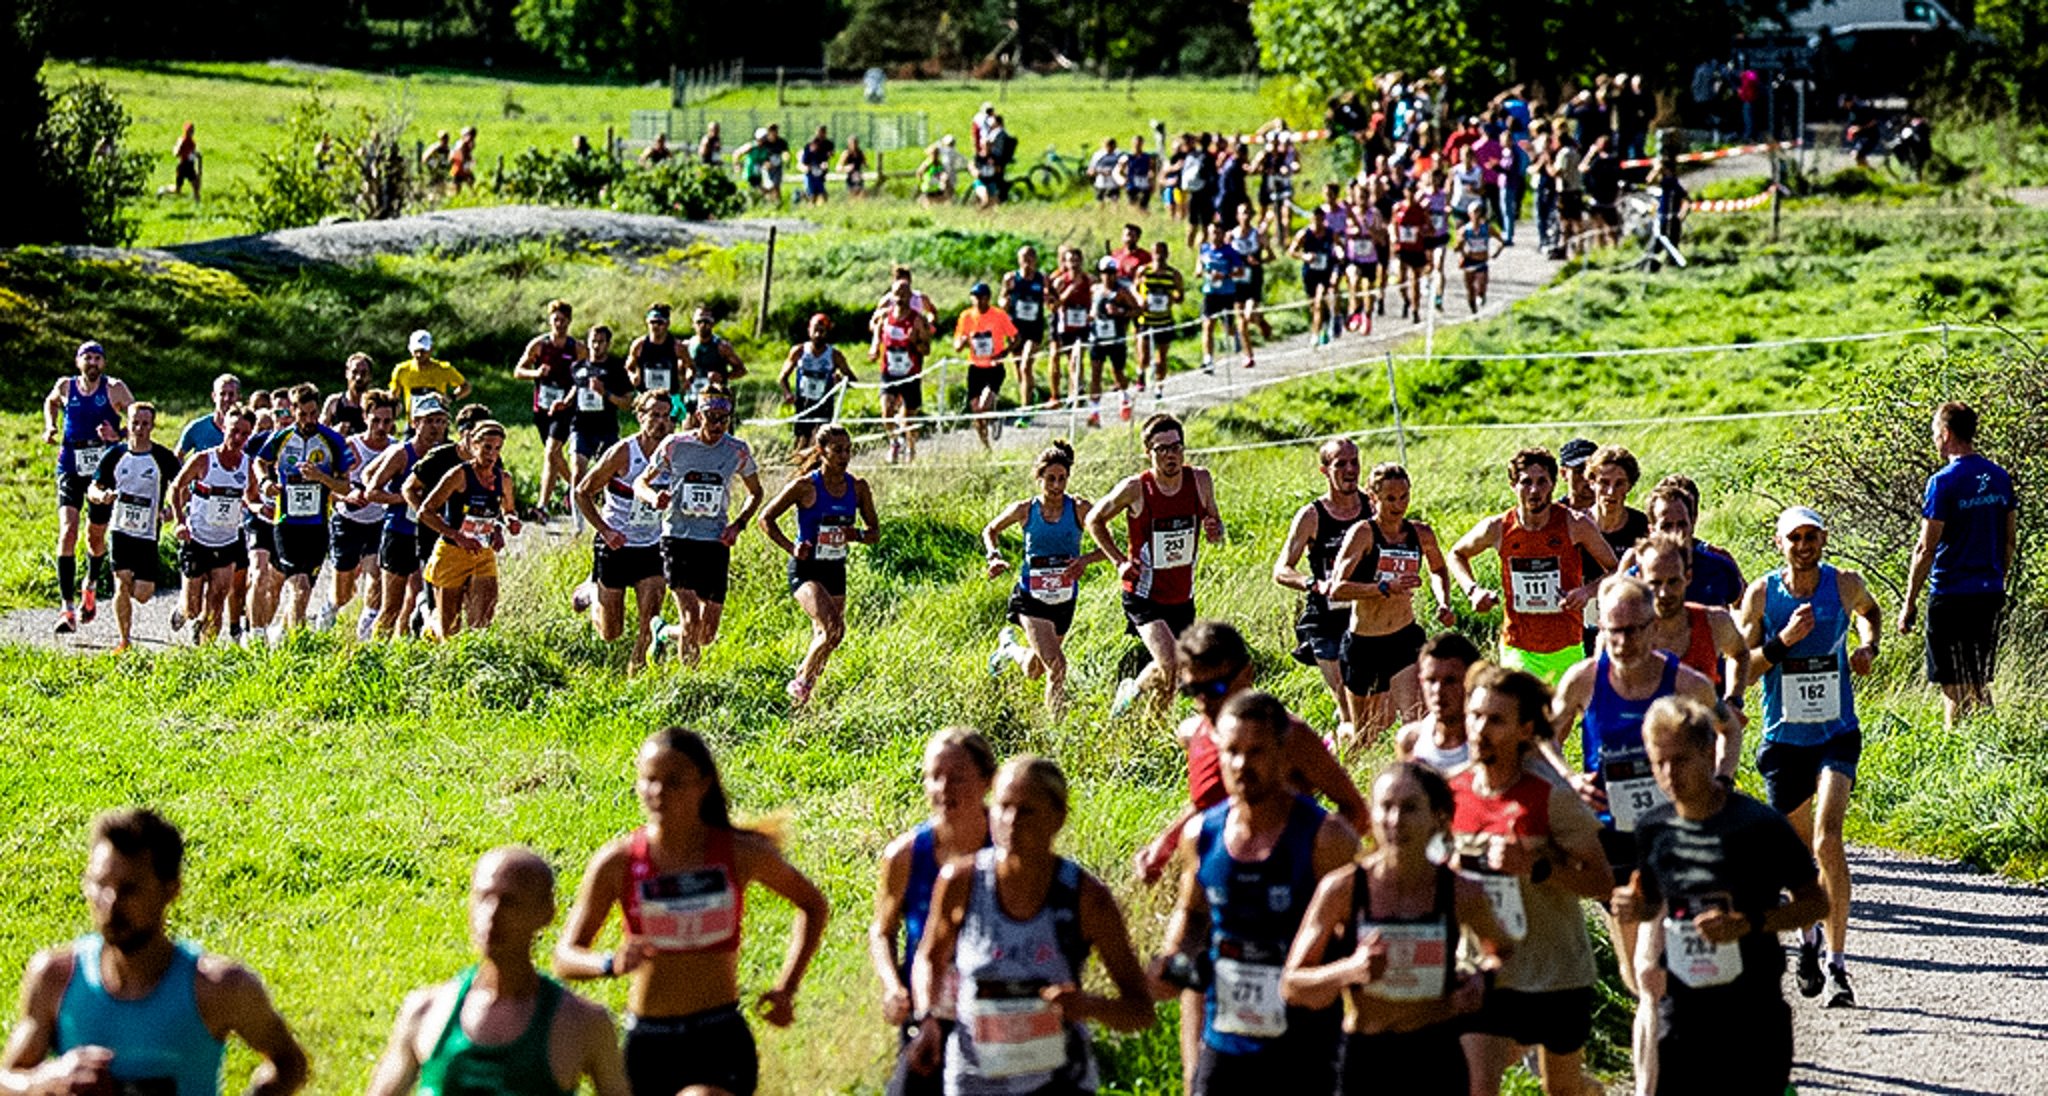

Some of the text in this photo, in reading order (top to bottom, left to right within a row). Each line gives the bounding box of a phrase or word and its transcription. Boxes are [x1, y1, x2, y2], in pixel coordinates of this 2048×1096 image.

[1524, 581, 1547, 595] 111
[1799, 683, 1826, 700] 162
[1631, 790, 1655, 809] 33
